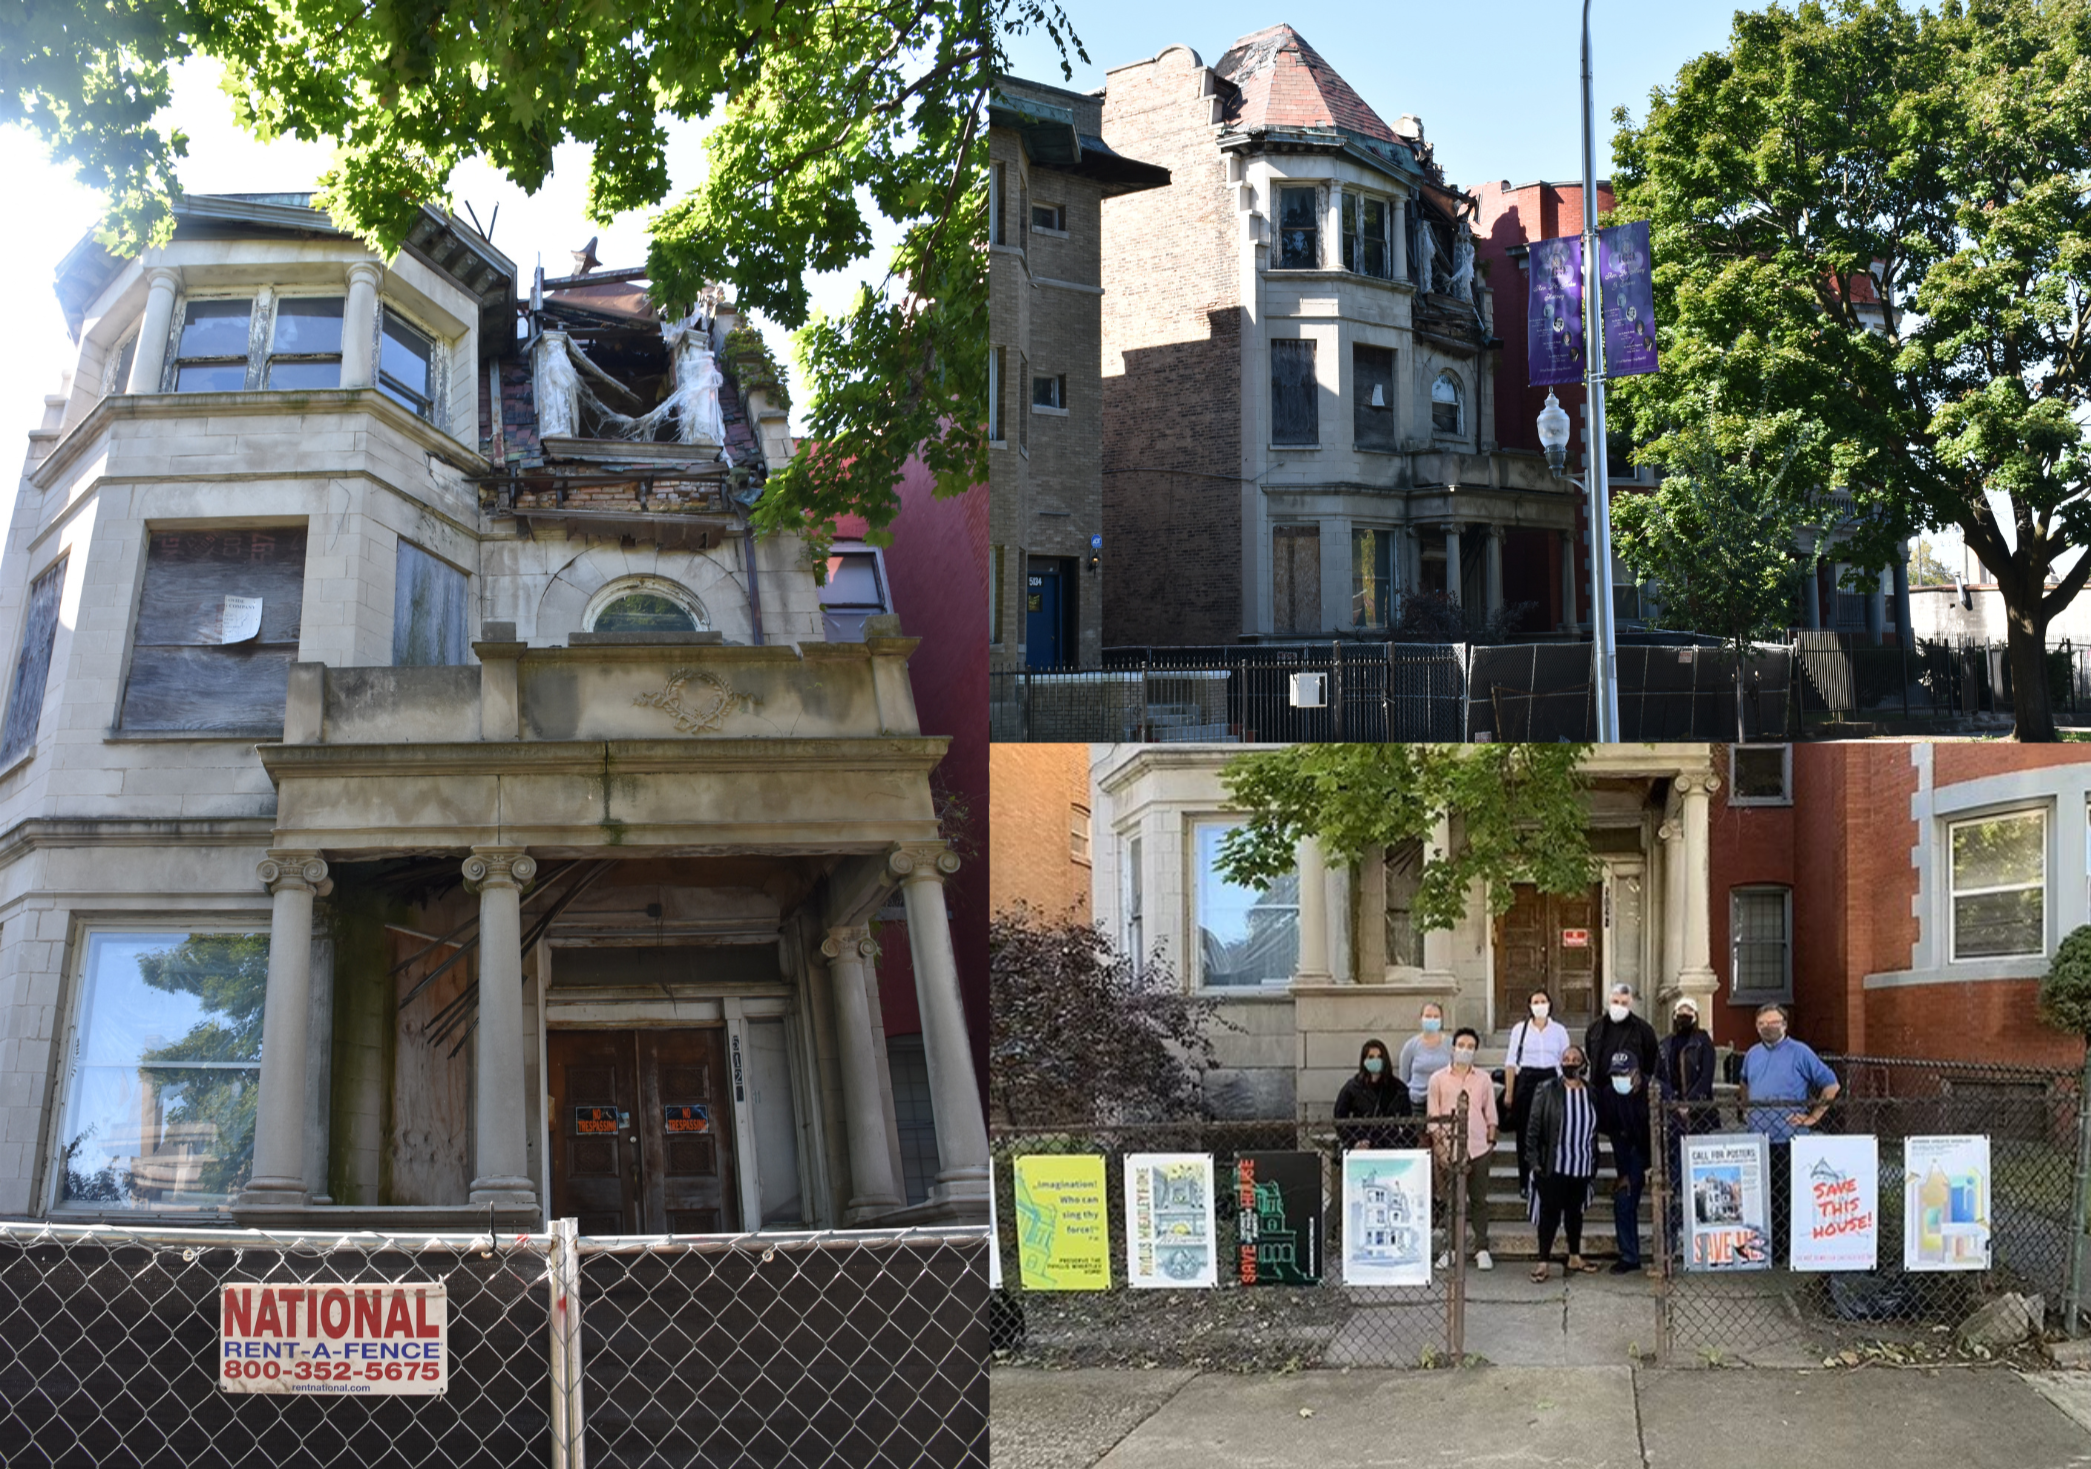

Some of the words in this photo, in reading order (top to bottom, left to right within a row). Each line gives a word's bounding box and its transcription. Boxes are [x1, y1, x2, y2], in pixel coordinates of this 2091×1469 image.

[1029, 576, 1042, 587] 5134
[592, 1108, 601, 1119] NO
[682, 1107, 691, 1119] NO
[577, 1119, 617, 1133] TRESPASSING
[667, 1118, 707, 1132] TRESPASSING
[1692, 1151, 1709, 1160] CALL
[1711, 1150, 1724, 1159] FOR
[1726, 1148, 1756, 1159] POSTERS
[1239, 1159, 1255, 1209] HOUSE
[1814, 1179, 1857, 1200] SAVE
[1059, 1196, 1080, 1204] Who
[1818, 1197, 1860, 1217] THIS
[1063, 1211, 1083, 1220] sing
[1083, 1211, 1098, 1220] thy
[1813, 1211, 1872, 1239] HOUSE!
[1694, 1232, 1733, 1262] SAVE
[1241, 1245, 1257, 1284] SAVE
[223, 1288, 440, 1340] NATIONAL
[224, 1341, 442, 1360] RENT-A-FENCE
[223, 1360, 440, 1381] 800-352-5675
[291, 1383, 371, 1393] rentnational.com
